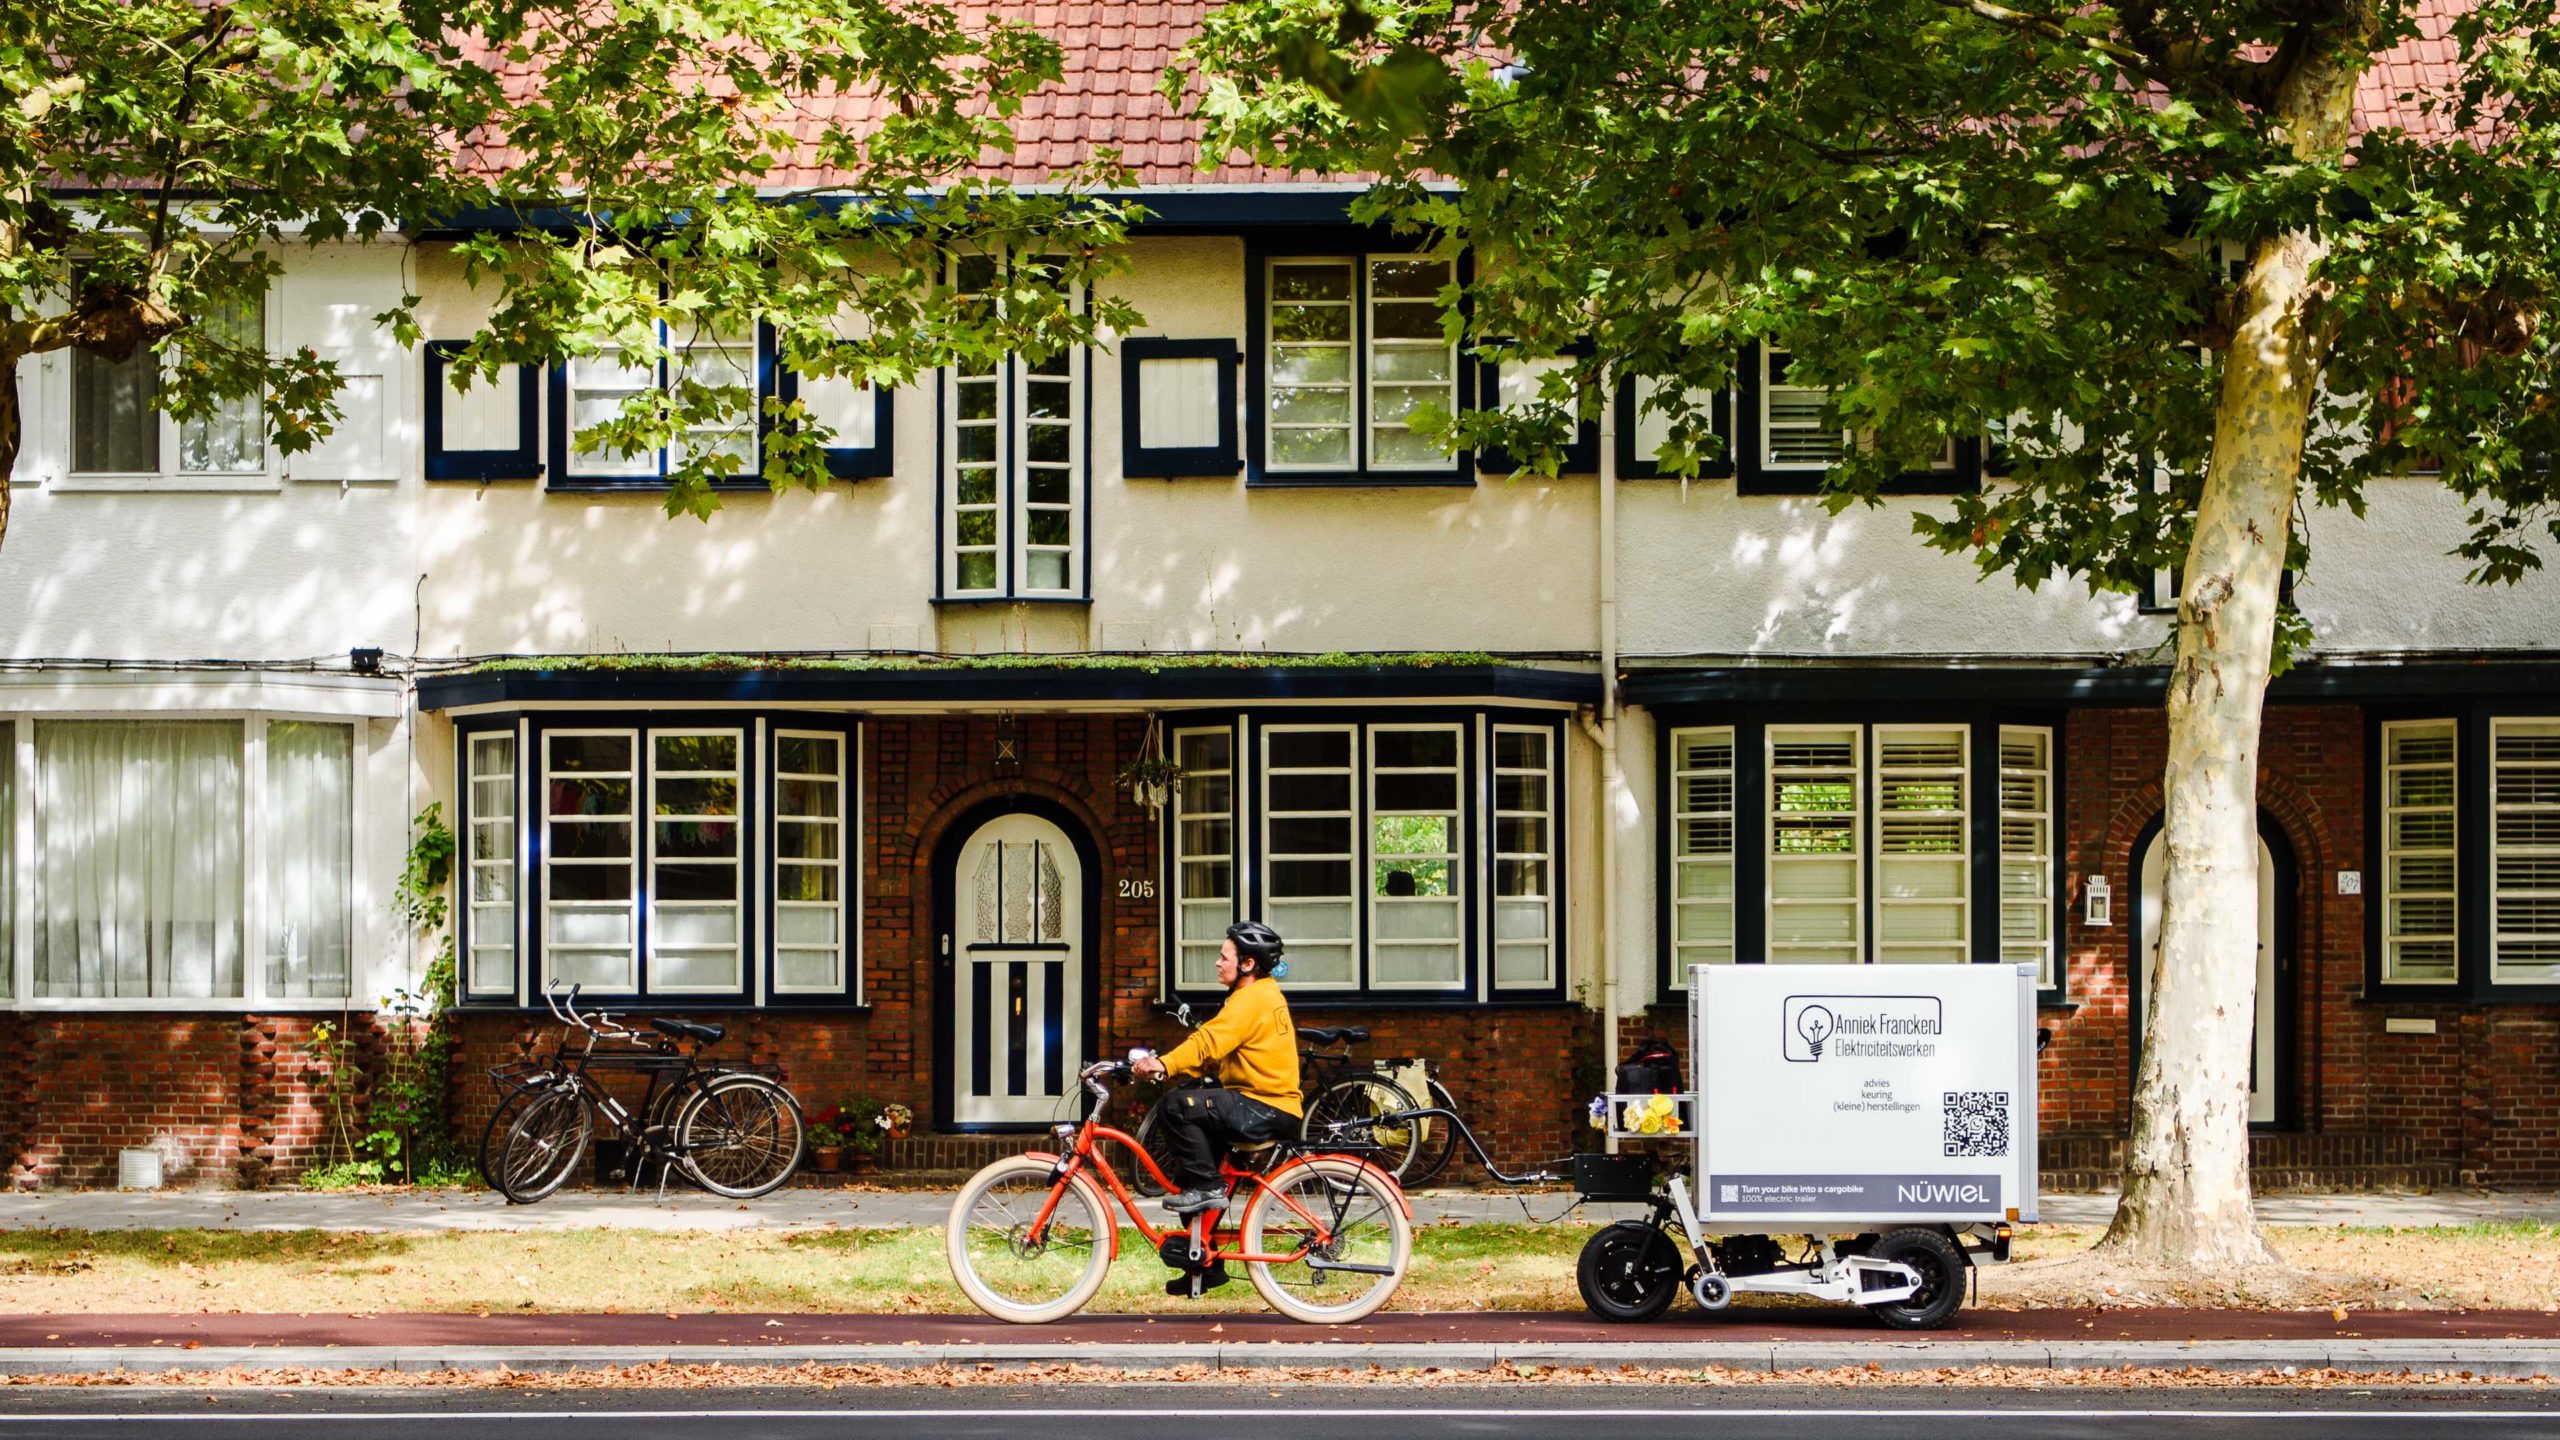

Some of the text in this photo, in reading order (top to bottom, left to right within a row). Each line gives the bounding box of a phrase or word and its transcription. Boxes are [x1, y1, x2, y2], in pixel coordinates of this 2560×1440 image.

[1119, 880, 1154, 898] 205
[1835, 1013, 1936, 1035] Anniek Francken
[1835, 1038, 1935, 1057] Elektriciteitswerken
[1864, 1079, 1890, 1088] advies
[1861, 1090, 1893, 1102] keuring
[1833, 1101, 1921, 1113] (kleine) herstellingen
[1742, 1185, 1760, 1193] Turn
[1761, 1186, 1780, 1195] your
[1781, 1185, 1799, 1193] bike
[1800, 1185, 1816, 1193] into
[1824, 1185, 1864, 1195] cargobike
[1741, 1195, 1817, 1203] 100% electric trailer
